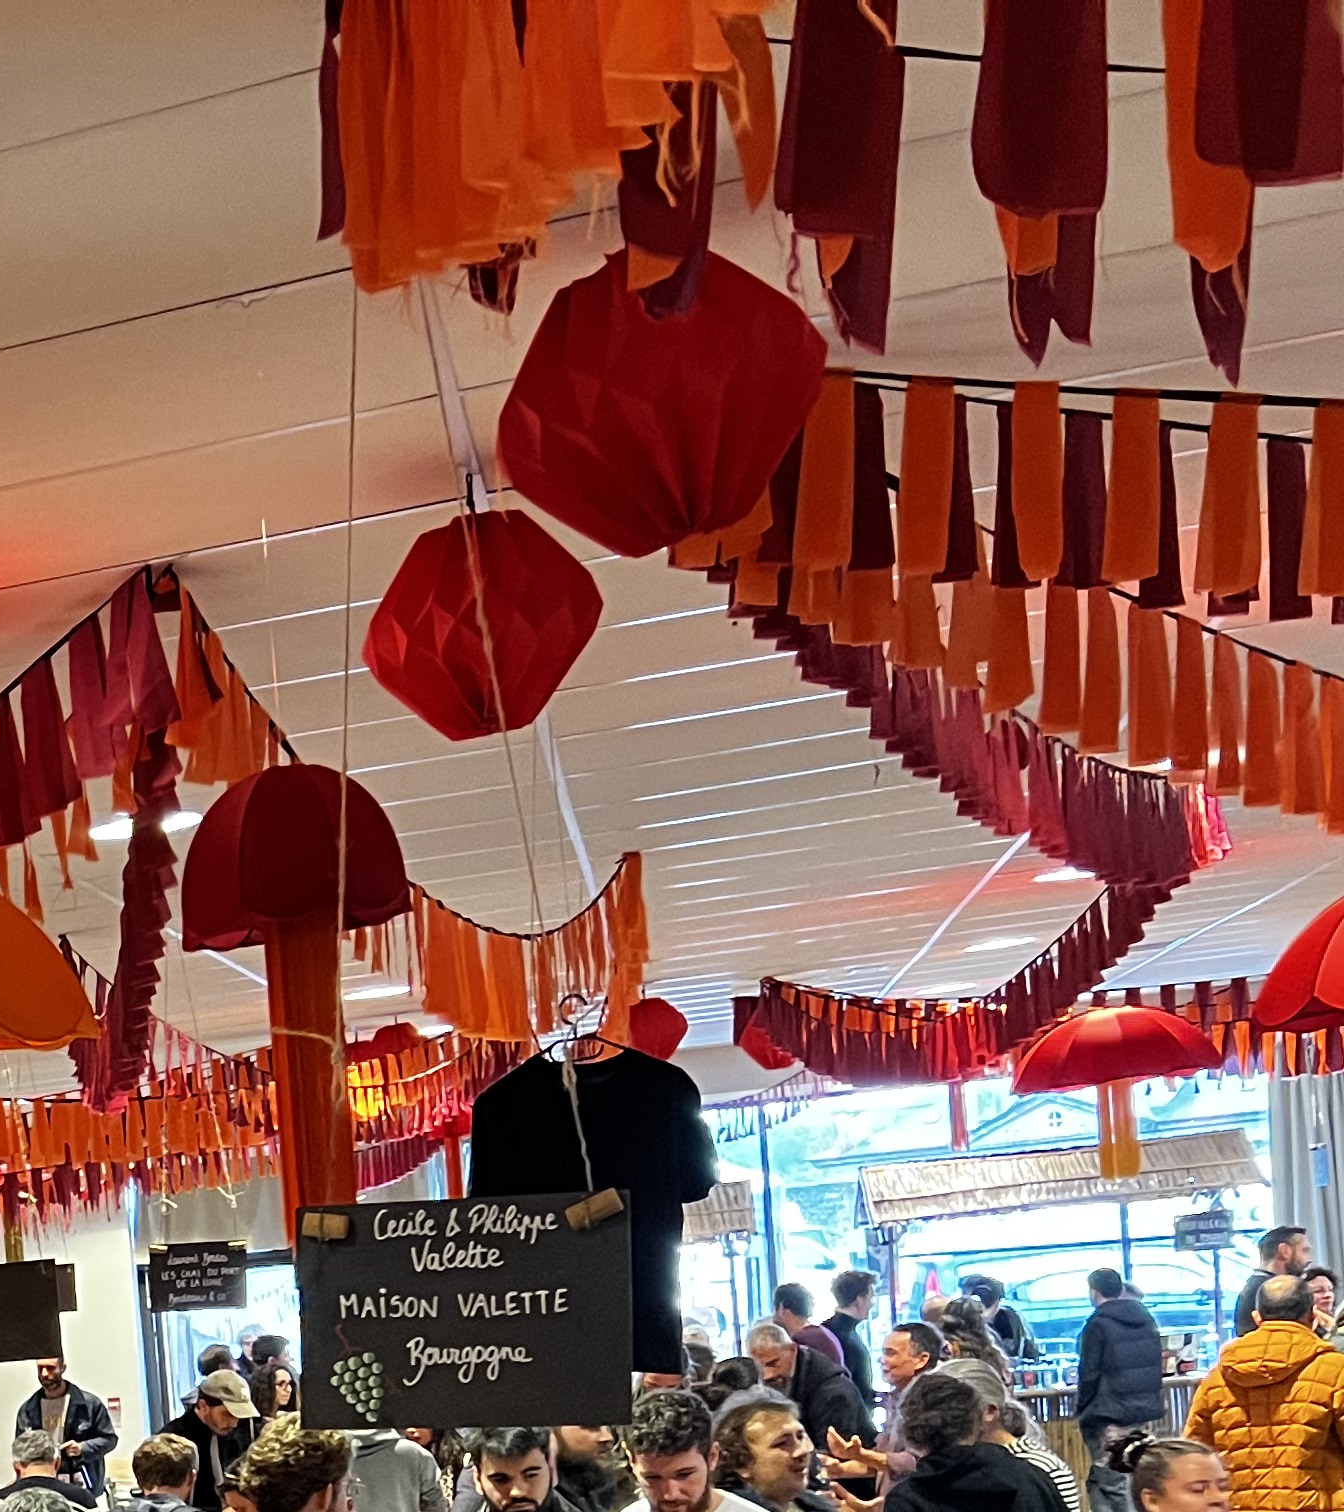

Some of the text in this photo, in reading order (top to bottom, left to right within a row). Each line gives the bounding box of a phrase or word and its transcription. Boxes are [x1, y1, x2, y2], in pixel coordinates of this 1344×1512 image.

[374, 1204, 560, 1244] Cecile & Philippe
[411, 1240, 505, 1273] Valette
[458, 1287, 570, 1317] VALETTE
[402, 1336, 533, 1387] Bourgogne
